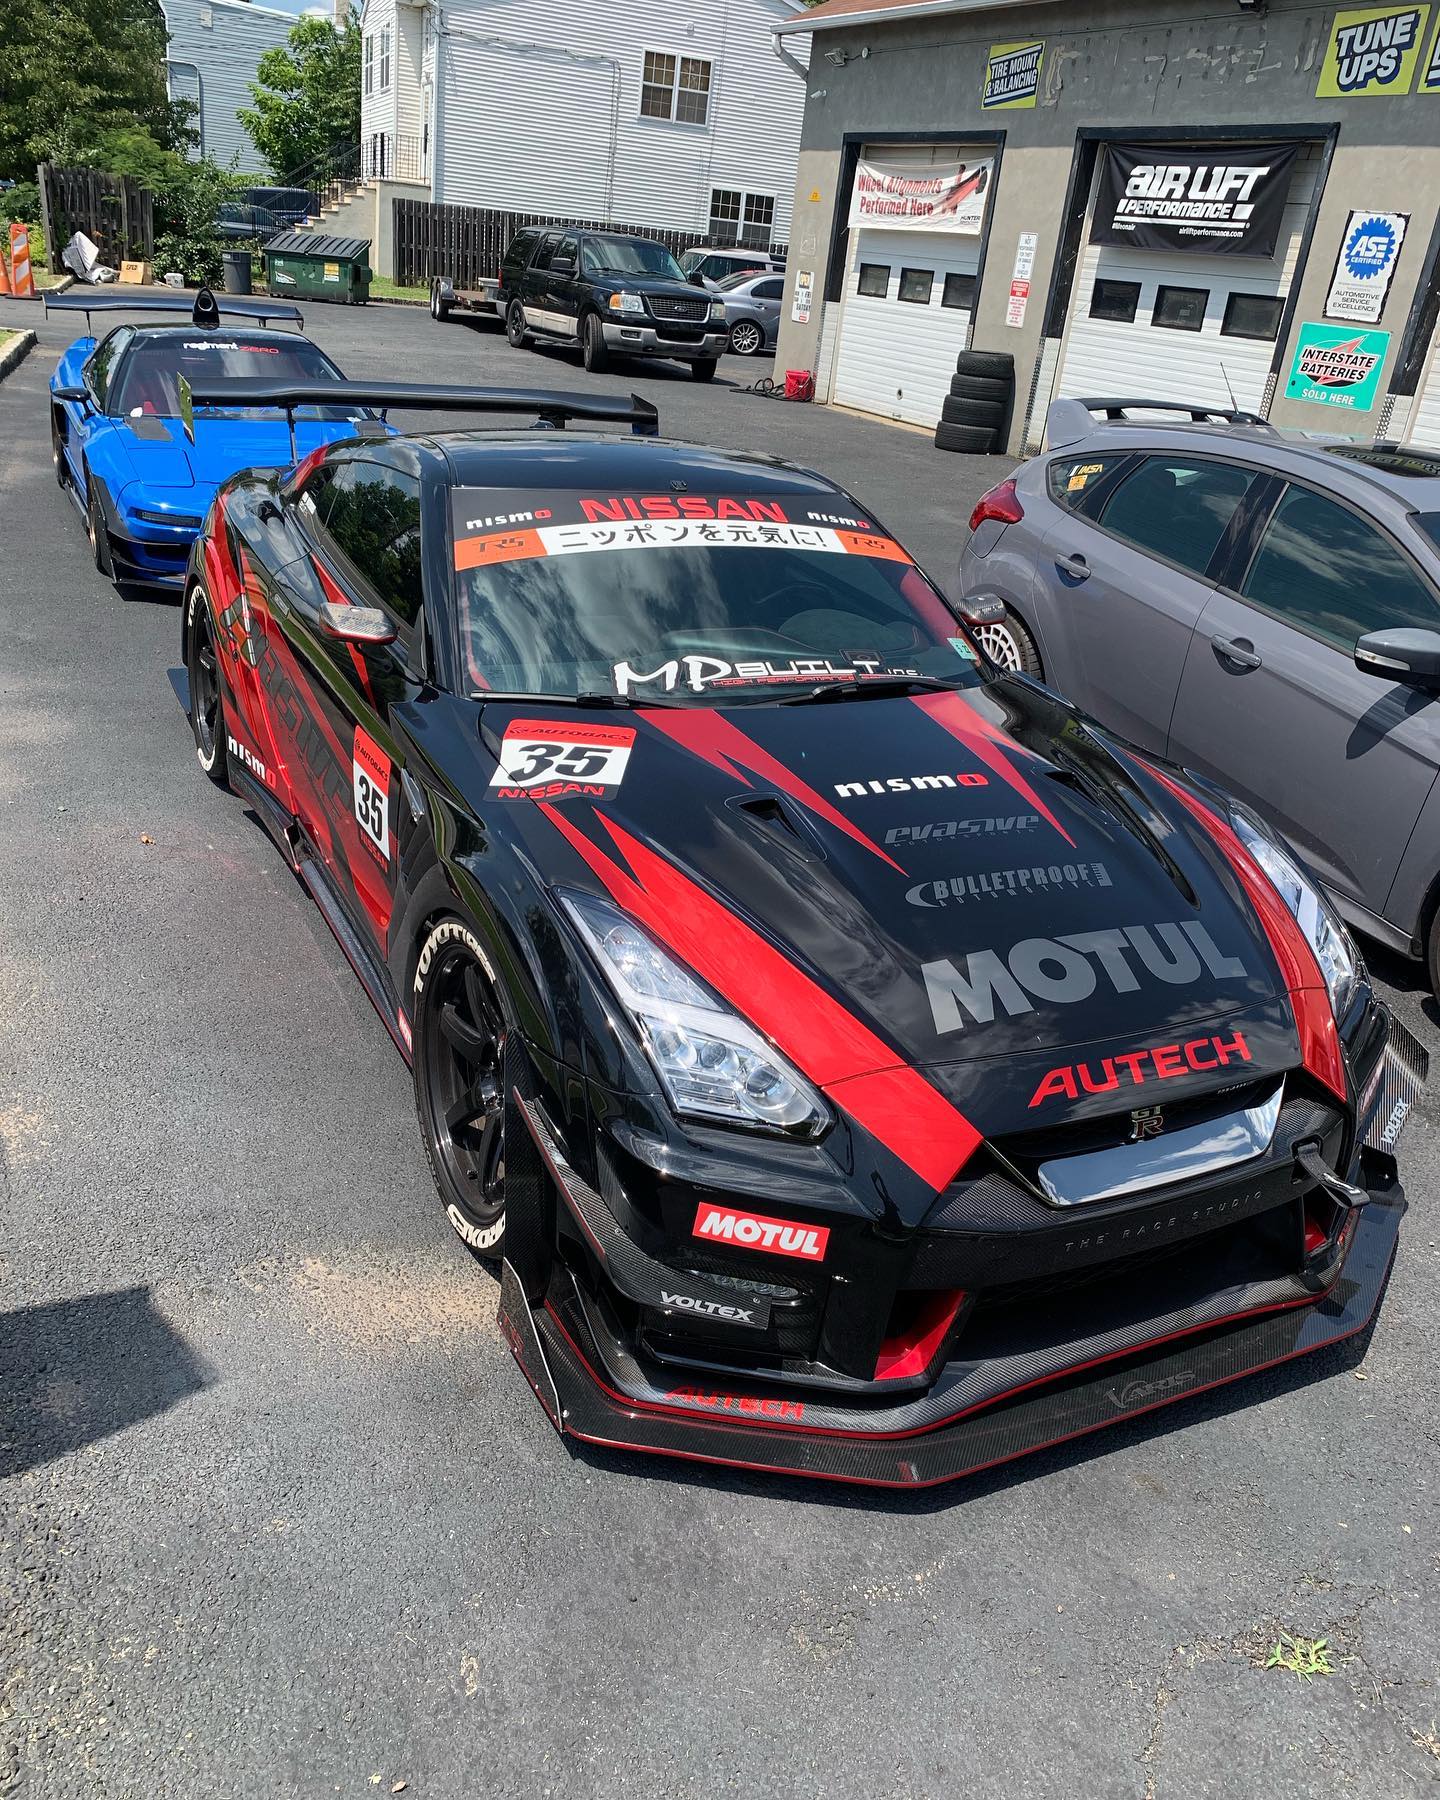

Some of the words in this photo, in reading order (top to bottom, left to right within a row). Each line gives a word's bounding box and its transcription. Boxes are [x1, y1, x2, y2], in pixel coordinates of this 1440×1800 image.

[1338, 13, 1416, 57] TUNE
[991, 61, 1010, 80] TIRE
[1009, 52, 1039, 76] MOUNT
[1339, 47, 1398, 85] UPS
[993, 68, 1038, 95] BALANCING
[858, 175, 884, 193] Wheel
[887, 176, 943, 196] Alignments
[1188, 166, 1270, 201] LIFT
[860, 196, 908, 215] Performed
[910, 199, 934, 216] Here
[1125, 199, 1233, 219] PERFORMANCE
[1179, 227, 1243, 238] airliftperformance.com
[1350, 235, 1390, 258] ASE
[1350, 257, 1382, 265] CERTIFIED
[1332, 302, 1376, 312] EXCELLENCE
[1335, 290, 1380, 300] AUTOMOTIVE
[1341, 297, 1371, 305] SERVICE
[1300, 362, 1366, 380] BATTERIES
[1302, 348, 1375, 368] INTERSTATE
[1301, 388, 1327, 401] SOLD
[1329, 393, 1356, 405] HERE
[466, 508, 552, 530] nismo
[579, 497, 789, 523] NISSAN
[807, 511, 871, 529] nismo
[532, 728, 631, 740] AUTOBACS
[228, 735, 276, 789] nismo
[360, 746, 388, 782] AUTOBACS
[508, 743, 613, 782] 35
[498, 782, 604, 799] NISSAN
[834, 773, 989, 797] nismo
[358, 774, 383, 842] 35
[885, 815, 1039, 844] evasive
[359, 828, 388, 873] NISSAN
[933, 863, 1089, 900] BULLETPROOF
[938, 881, 1095, 907] AUTOMOTIVE
[921, 920, 1248, 1035] MOTUL
[1028, 1031, 1252, 1109] AUTECH
[1381, 1098, 1409, 1144] VOLTEX
[699, 1211, 820, 1255] MOTUL
[1065, 1234, 1106, 1252] THE
[1122, 1217, 1176, 1239] RACE
[1191, 1190, 1262, 1220] STUDIO
[660, 1290, 754, 1321] VOLTEX
[663, 1384, 806, 1421] AUTECH
